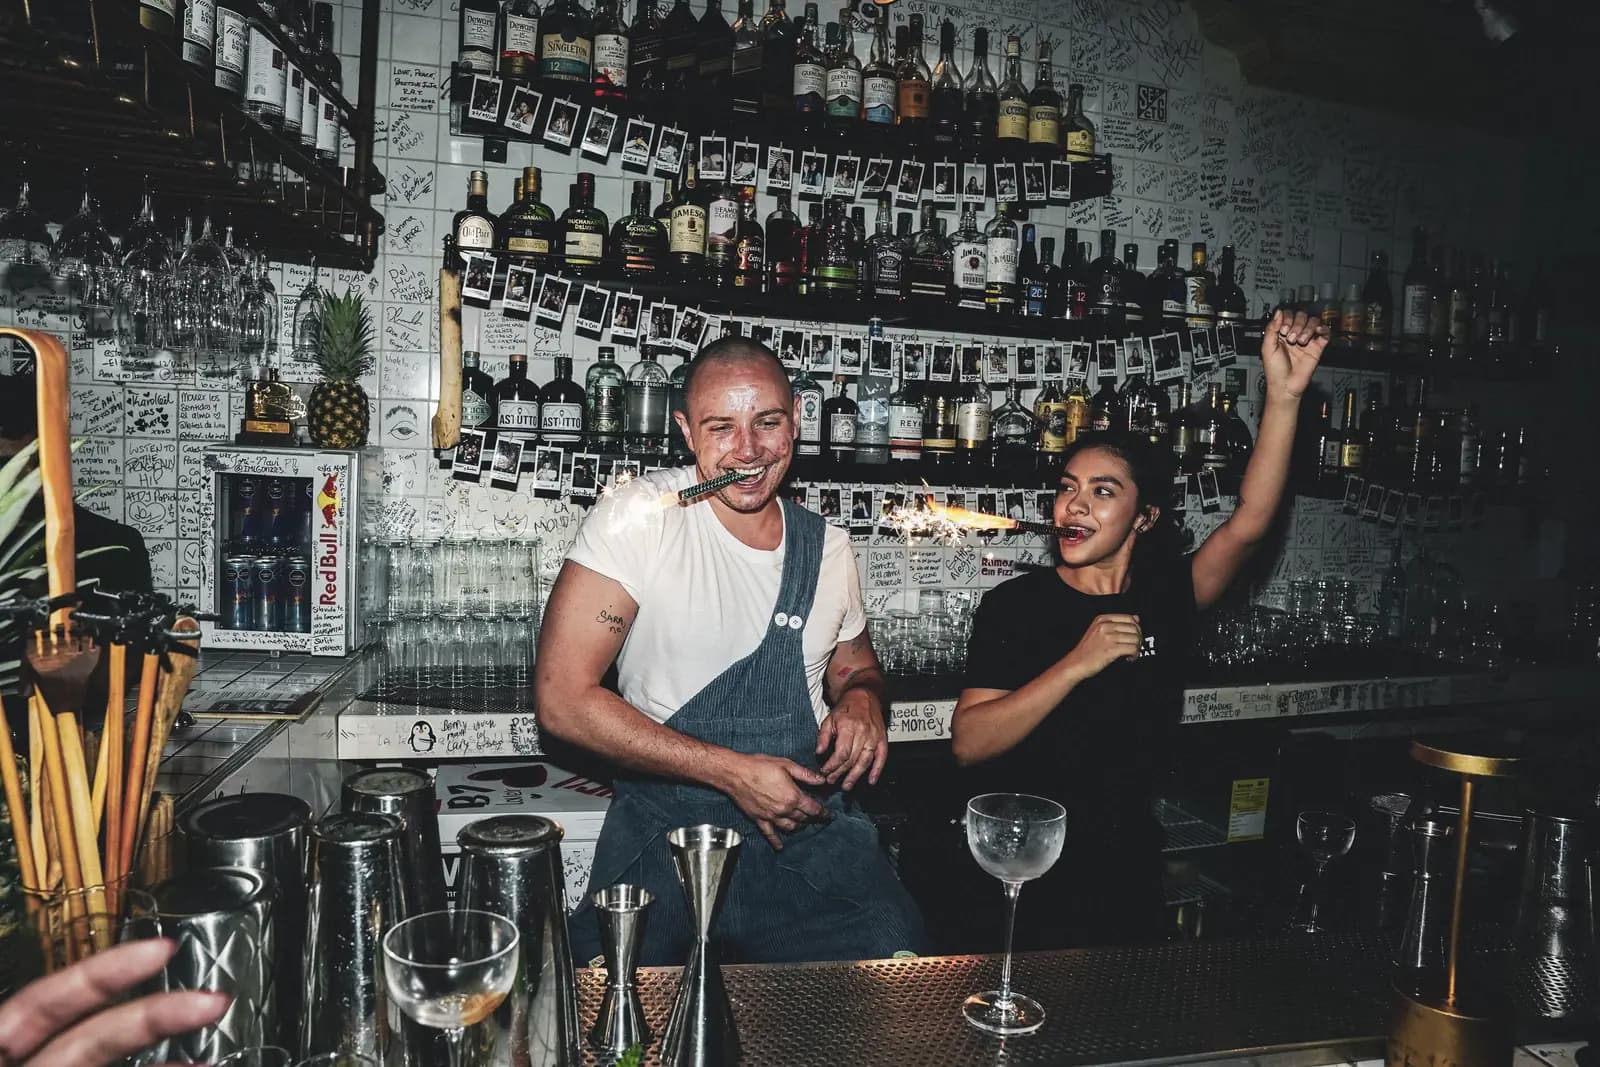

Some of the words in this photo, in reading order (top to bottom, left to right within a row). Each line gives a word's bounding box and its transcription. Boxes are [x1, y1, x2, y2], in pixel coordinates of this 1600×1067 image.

[548, 41, 587, 57] SINGLETON
[551, 62, 560, 71] 12
[500, 414, 537, 426] ASTUTTO
[543, 415, 581, 428] ASTUTTO
[319, 533, 337, 567] Bull
[981, 558, 1014, 567] Ramos
[997, 568, 1013, 576] Fizz
[319, 571, 337, 605] Red
